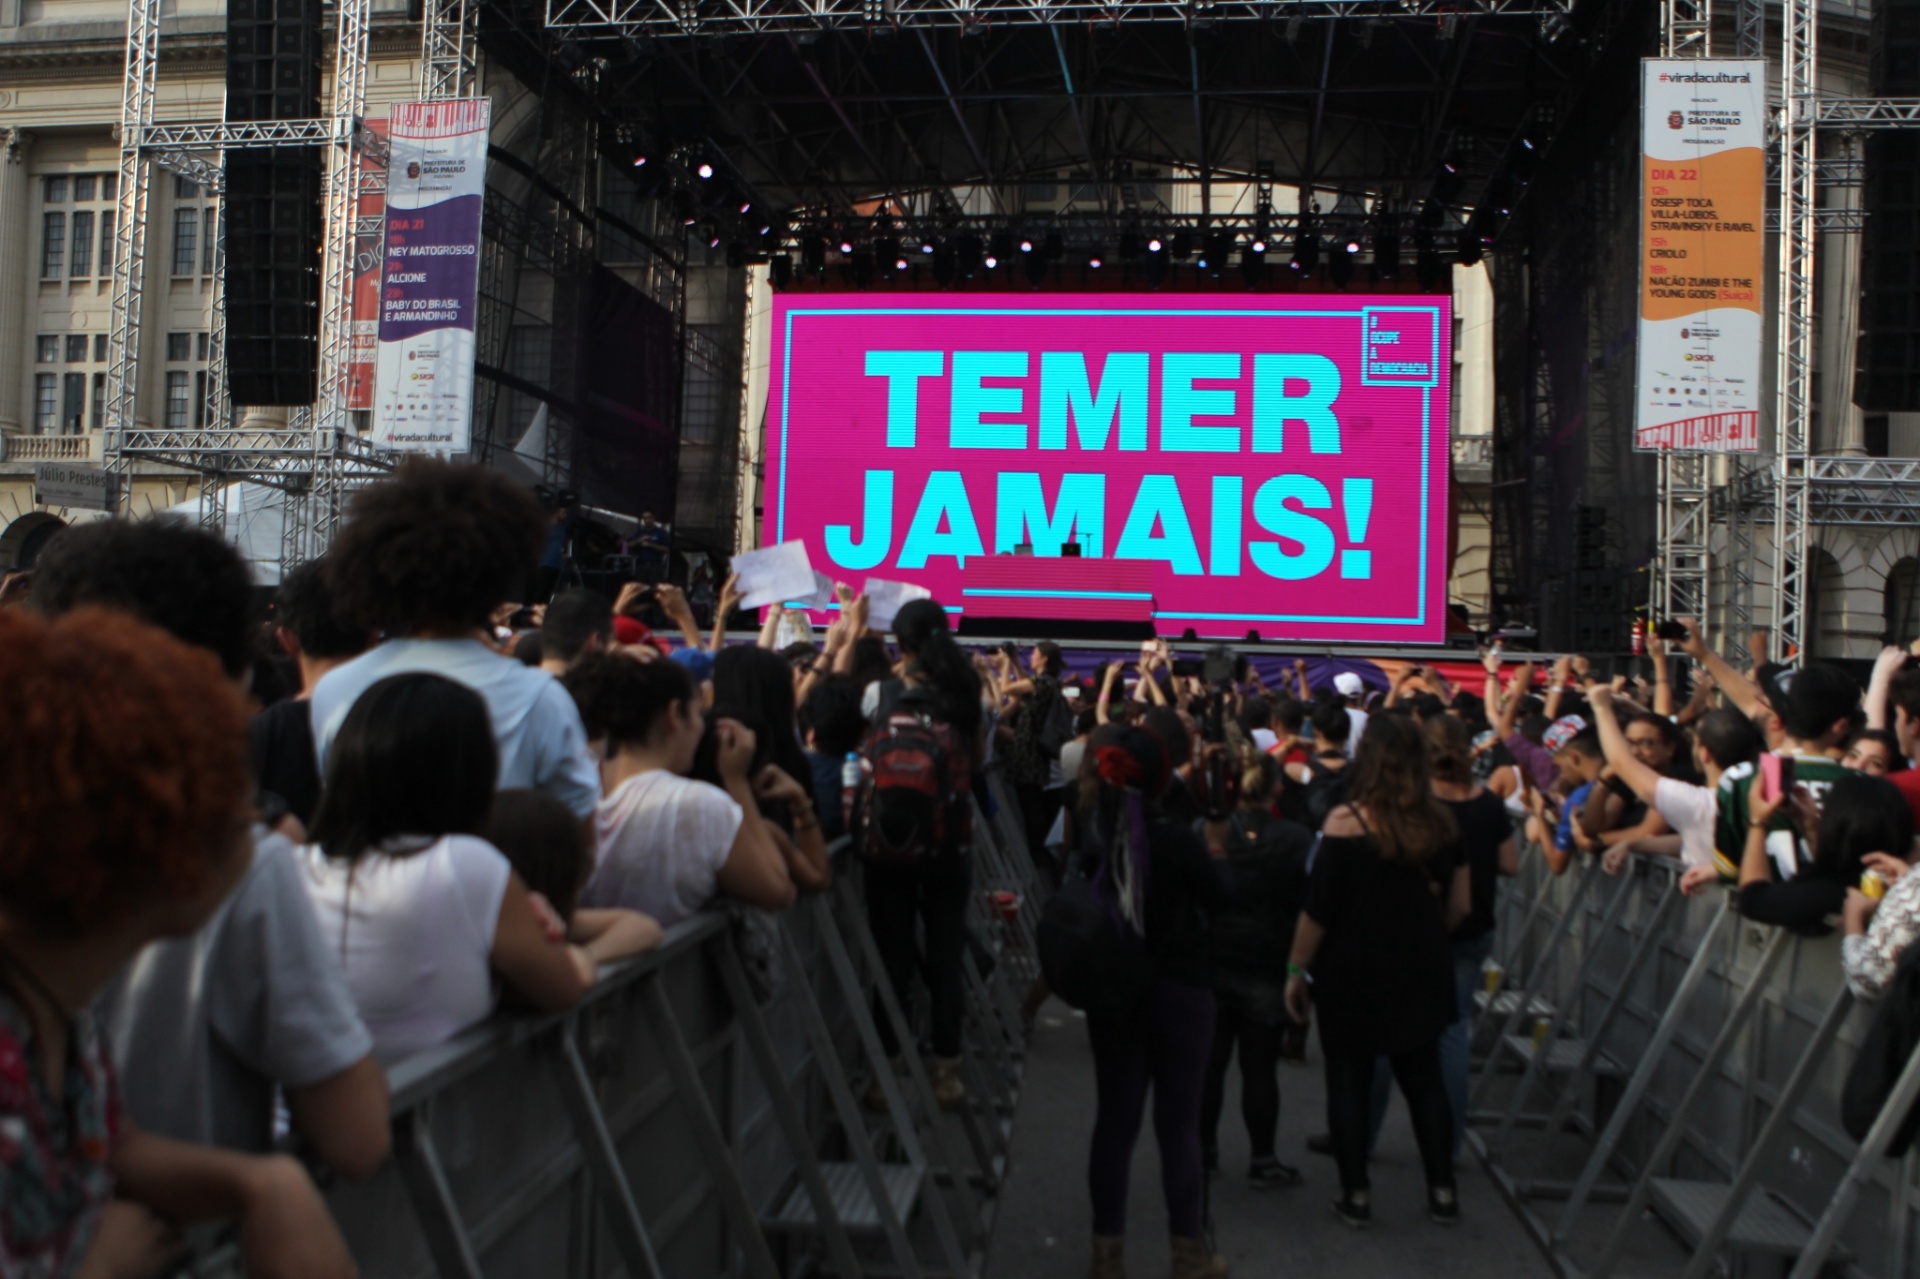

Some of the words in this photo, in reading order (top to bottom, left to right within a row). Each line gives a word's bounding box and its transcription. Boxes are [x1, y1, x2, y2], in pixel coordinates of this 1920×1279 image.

[1659, 72, 1751, 83] #viradacultural
[1689, 117, 1708, 125] SÃO
[1652, 169, 1675, 180] DIA
[1680, 170, 1697, 180] 22
[1651, 198, 1683, 207] OSESP
[1687, 199, 1713, 207] TOCA
[390, 220, 409, 230] DIA
[413, 219, 424, 230] 21
[1651, 222, 1712, 231] STRAVINSKY
[1716, 223, 1722, 231] E
[390, 246, 408, 257] NEY
[410, 245, 475, 256] MATOGROSSO
[1650, 249, 1687, 259] CRIOLO
[388, 273, 427, 283] ALCIONE
[1688, 278, 1721, 287] ZUMBI
[1723, 279, 1730, 287] E
[1732, 279, 1752, 288] THE
[1650, 289, 1685, 298] YOUNG
[1688, 290, 1716, 299] GODS
[386, 300, 411, 310] BABY
[413, 300, 427, 310] DO
[429, 299, 461, 309] BRASIL
[386, 312, 391, 322] E
[394, 311, 457, 321] ARMANDINHO
[865, 350, 1341, 454] TEMER
[40, 466, 65, 483] Júlio
[69, 470, 106, 488] Prestes
[824, 469, 1373, 581] JAMAIS!
